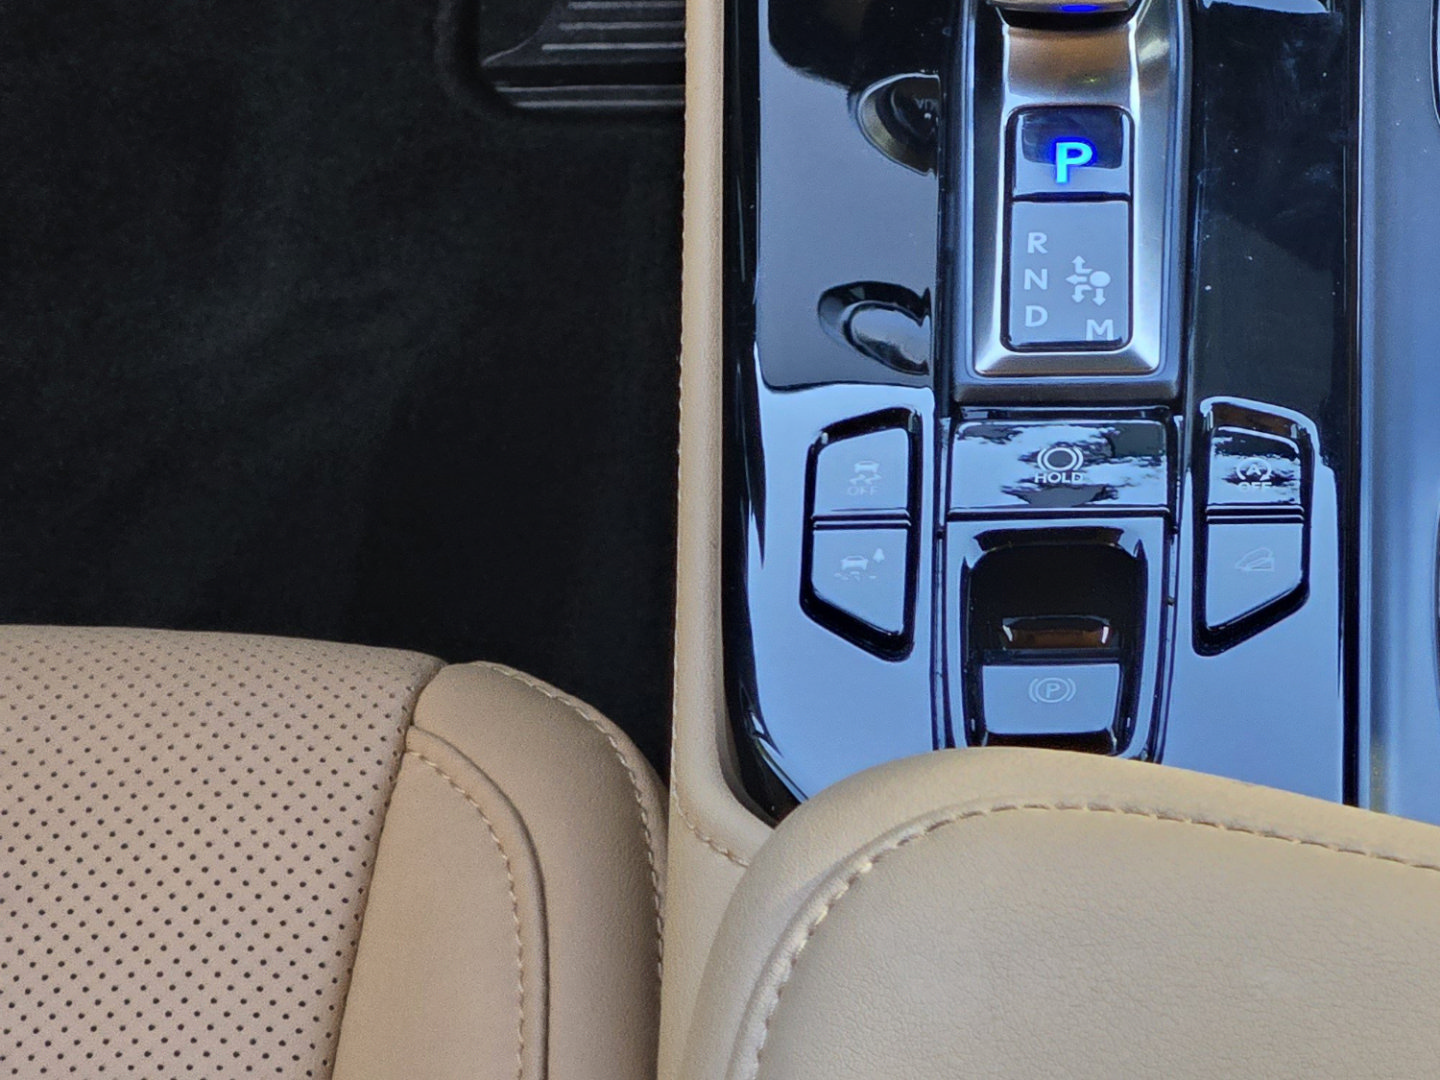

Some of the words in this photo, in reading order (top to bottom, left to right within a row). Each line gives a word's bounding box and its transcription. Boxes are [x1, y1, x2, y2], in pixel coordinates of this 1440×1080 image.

[1055, 141, 1094, 183] P
[1027, 232, 1048, 254] R
[1024, 269, 1048, 290] N
[1025, 305, 1049, 327] D
[1086, 319, 1114, 341] M
[1034, 471, 1083, 484] HOLD
